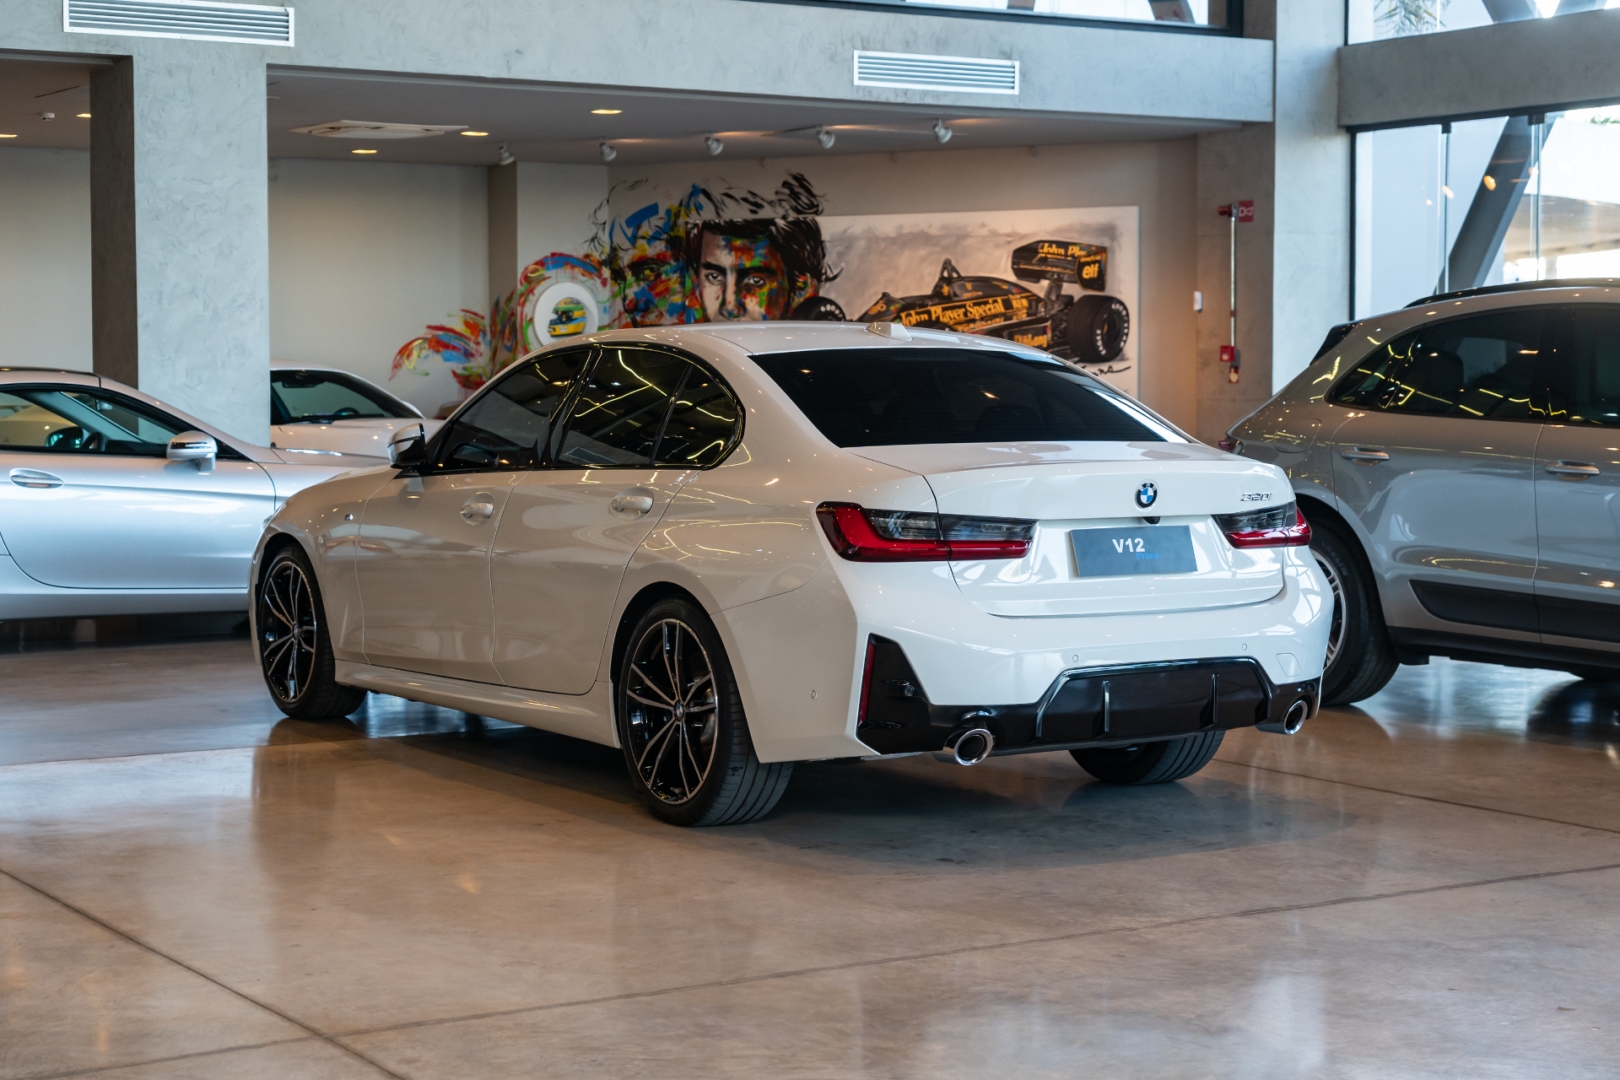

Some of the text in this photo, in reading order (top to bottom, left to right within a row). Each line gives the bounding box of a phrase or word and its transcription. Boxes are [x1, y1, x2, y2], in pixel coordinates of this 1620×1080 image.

[1039, 243, 1065, 256] John
[1082, 263, 1100, 280] elf
[900, 309, 929, 327] John
[930, 305, 966, 325] Player
[966, 298, 1006, 320] Special
[1112, 538, 1146, 554] V12
[1136, 552, 1160, 560] Prime
